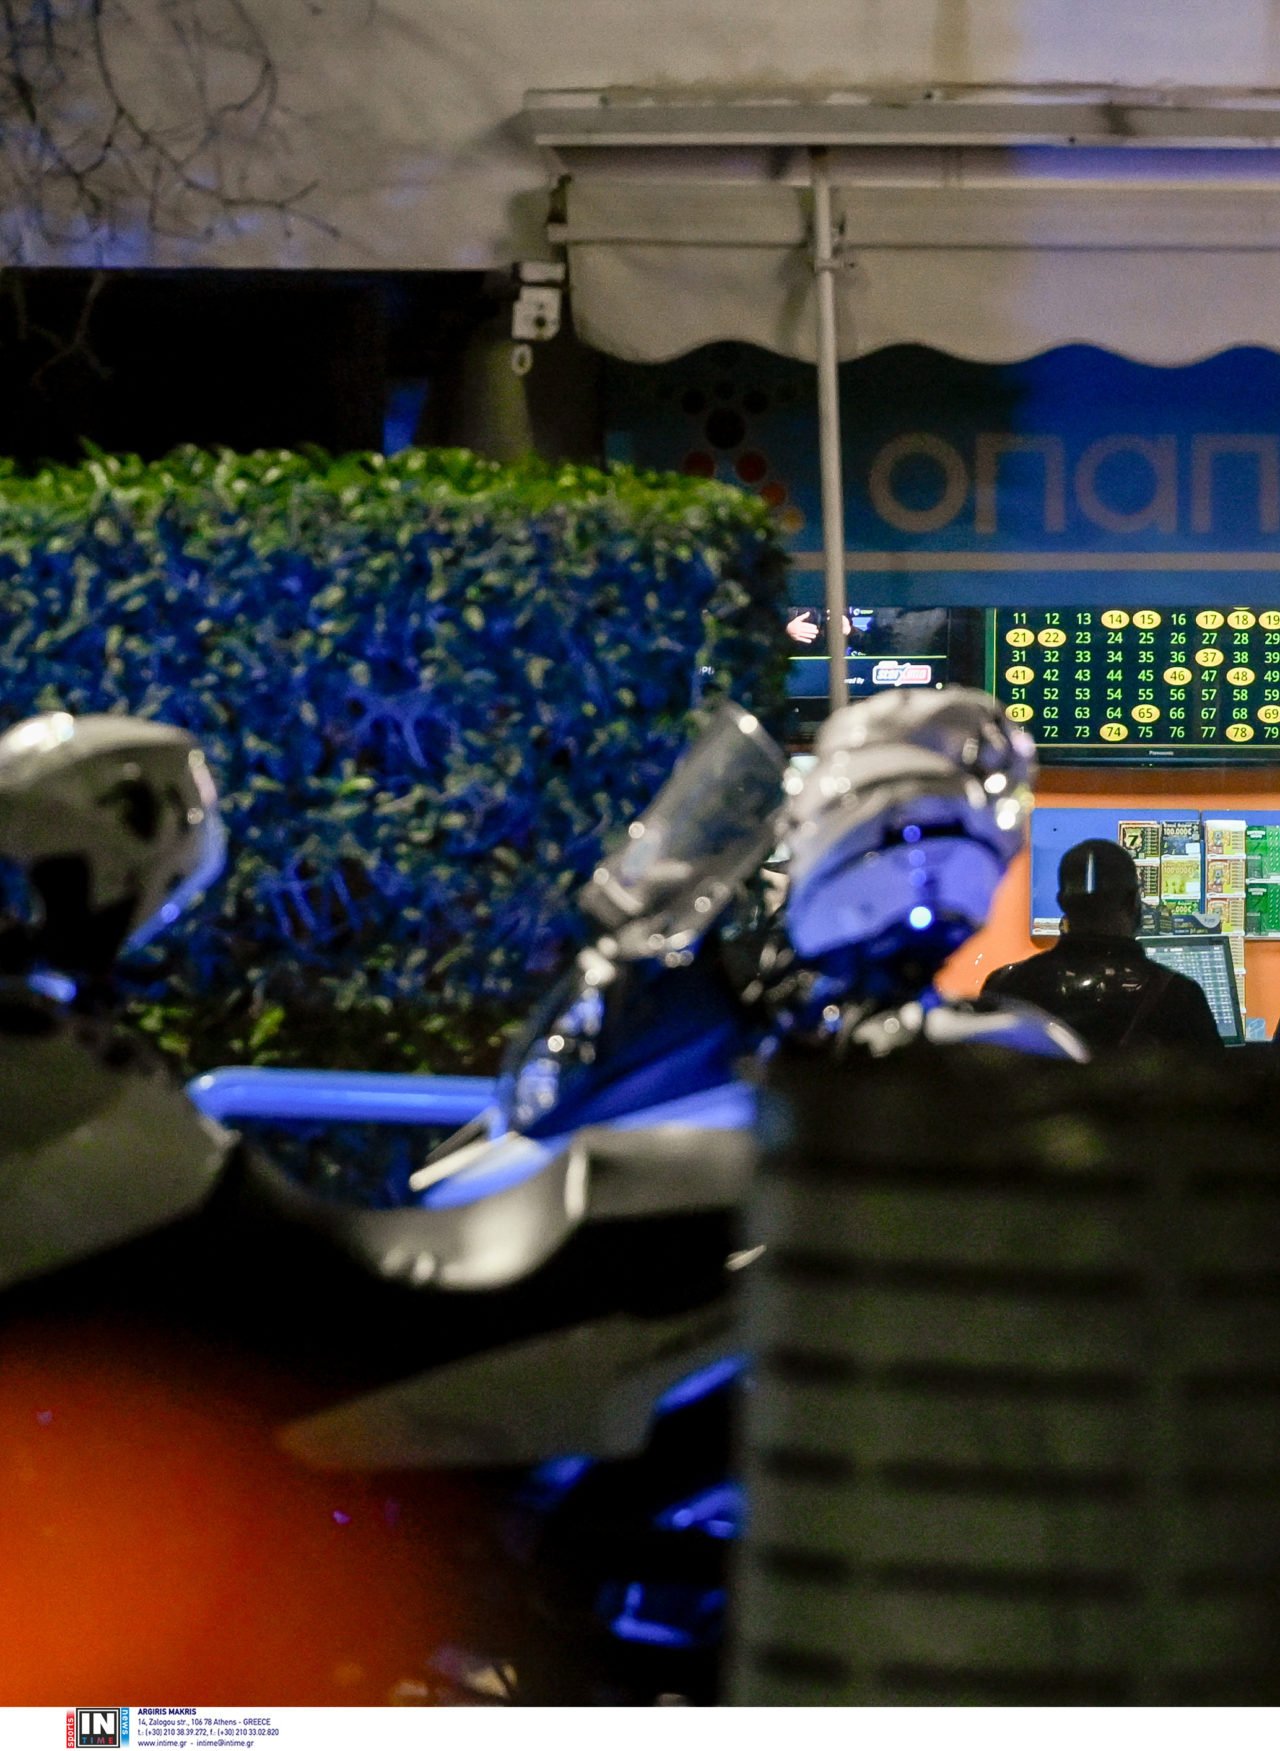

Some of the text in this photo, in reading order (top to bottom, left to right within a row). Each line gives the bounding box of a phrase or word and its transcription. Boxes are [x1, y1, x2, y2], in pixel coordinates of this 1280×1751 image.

[1014, 613, 1026, 624] 11
[1045, 613, 1059, 624] 12
[1077, 613, 1091, 625] 13
[1109, 614, 1122, 624] 14
[1141, 614, 1154, 625] 15
[1171, 614, 1186, 625] 16
[1204, 614, 1217, 625] 17
[1235, 614, 1249, 626] 18
[1267, 614, 1280, 626] 19
[1012, 631, 1026, 643] 21
[1044, 632, 1059, 643] 22
[1076, 632, 1091, 644] 23
[1107, 632, 1123, 644] 24
[1139, 632, 1154, 644] 25
[1170, 632, 1186, 644] 26
[1202, 633, 1217, 644] 27
[1233, 633, 1249, 644] 28
[1265, 633, 1280, 645] 29
[1012, 650, 1025, 662] 31
[1044, 651, 1059, 662] 32
[1075, 651, 1091, 662] 33
[1107, 651, 1123, 662] 34
[1139, 651, 1154, 663] 35
[1170, 651, 1185, 663] 36
[1202, 651, 1217, 663] 37
[1233, 651, 1248, 663] 38
[1264, 652, 1280, 663] 39
[1011, 669, 1026, 680] 41
[1043, 669, 1059, 681] 42
[1075, 669, 1090, 681] 43
[1107, 670, 1122, 681] 44
[1138, 670, 1154, 681] 45
[1169, 670, 1185, 681] 46
[1201, 670, 1217, 682] 47
[1233, 671, 1248, 682] 48
[1264, 671, 1280, 682] 49
[1012, 688, 1025, 699] 51
[1044, 688, 1058, 700] 52
[1075, 688, 1090, 700] 53
[1107, 688, 1122, 700] 54
[1138, 689, 1153, 700] 55
[1170, 689, 1185, 700] 56
[1201, 689, 1217, 700] 57
[1233, 689, 1248, 701] 58
[1264, 689, 1279, 701] 59
[1011, 707, 1025, 718] 61
[1043, 707, 1058, 718] 62
[1075, 707, 1090, 718] 63
[1107, 707, 1122, 719] 64
[1138, 707, 1153, 719] 65
[1170, 707, 1185, 719] 66
[1201, 708, 1216, 719] 67
[1233, 708, 1247, 719] 68
[1264, 708, 1279, 720] 69
[1043, 726, 1058, 737] 72
[1075, 726, 1089, 737] 73
[1107, 726, 1121, 737] 74
[1138, 726, 1153, 737] 75
[1169, 727, 1184, 738] 76
[1201, 727, 1216, 738] 77
[1233, 727, 1248, 739] 78
[1264, 727, 1279, 738] 79
[1127, 834, 1139, 847] 7
